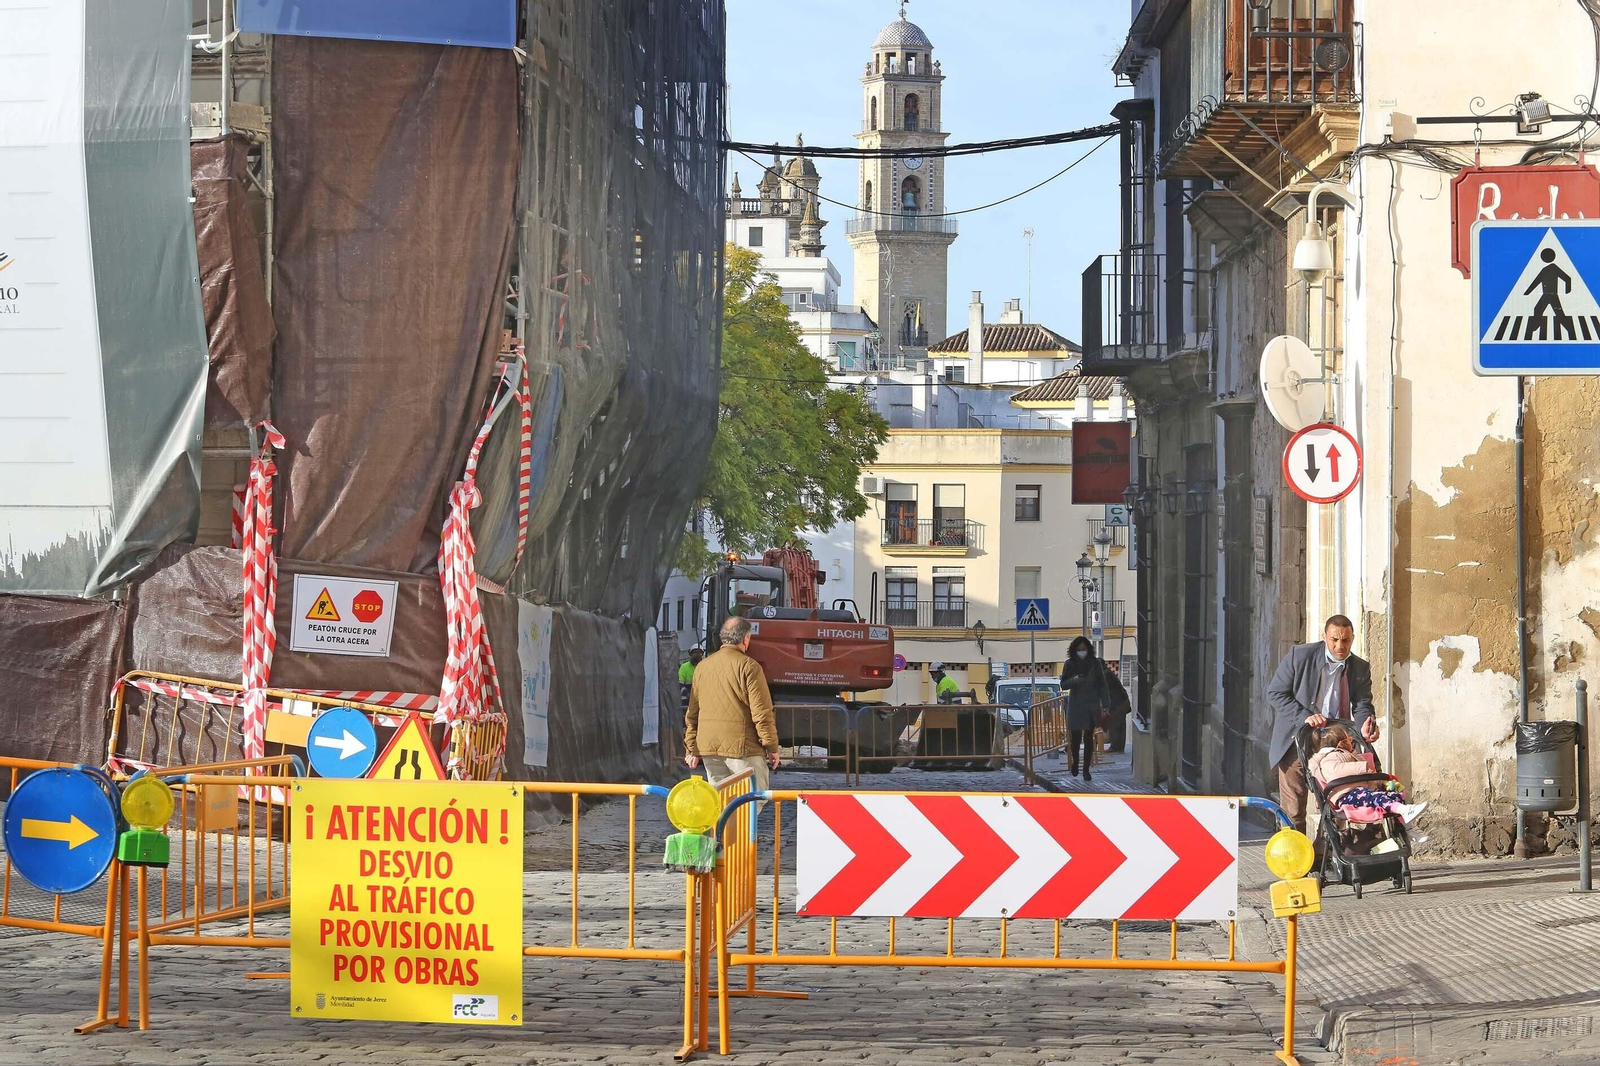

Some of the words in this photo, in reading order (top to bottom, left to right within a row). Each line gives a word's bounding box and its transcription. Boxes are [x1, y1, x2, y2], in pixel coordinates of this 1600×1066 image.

[1111, 504, 1123, 524] CA
[354, 603, 380, 611] STOP
[765, 607, 775, 616] 25
[338, 626, 362, 634] CRUCE
[818, 629, 864, 639] HITACHI
[326, 798, 488, 844] ATENCIÓN
[359, 850, 453, 879] DESVIO
[329, 884, 359, 912] AL
[367, 877, 475, 915] TRÁFICO
[320, 918, 494, 951] PROVISIONAL
[334, 954, 385, 983] POR
[394, 956, 479, 986] OBRAS
[330, 995, 365, 1003] Ayuntamiento
[454, 1004, 478, 1016] FCC
